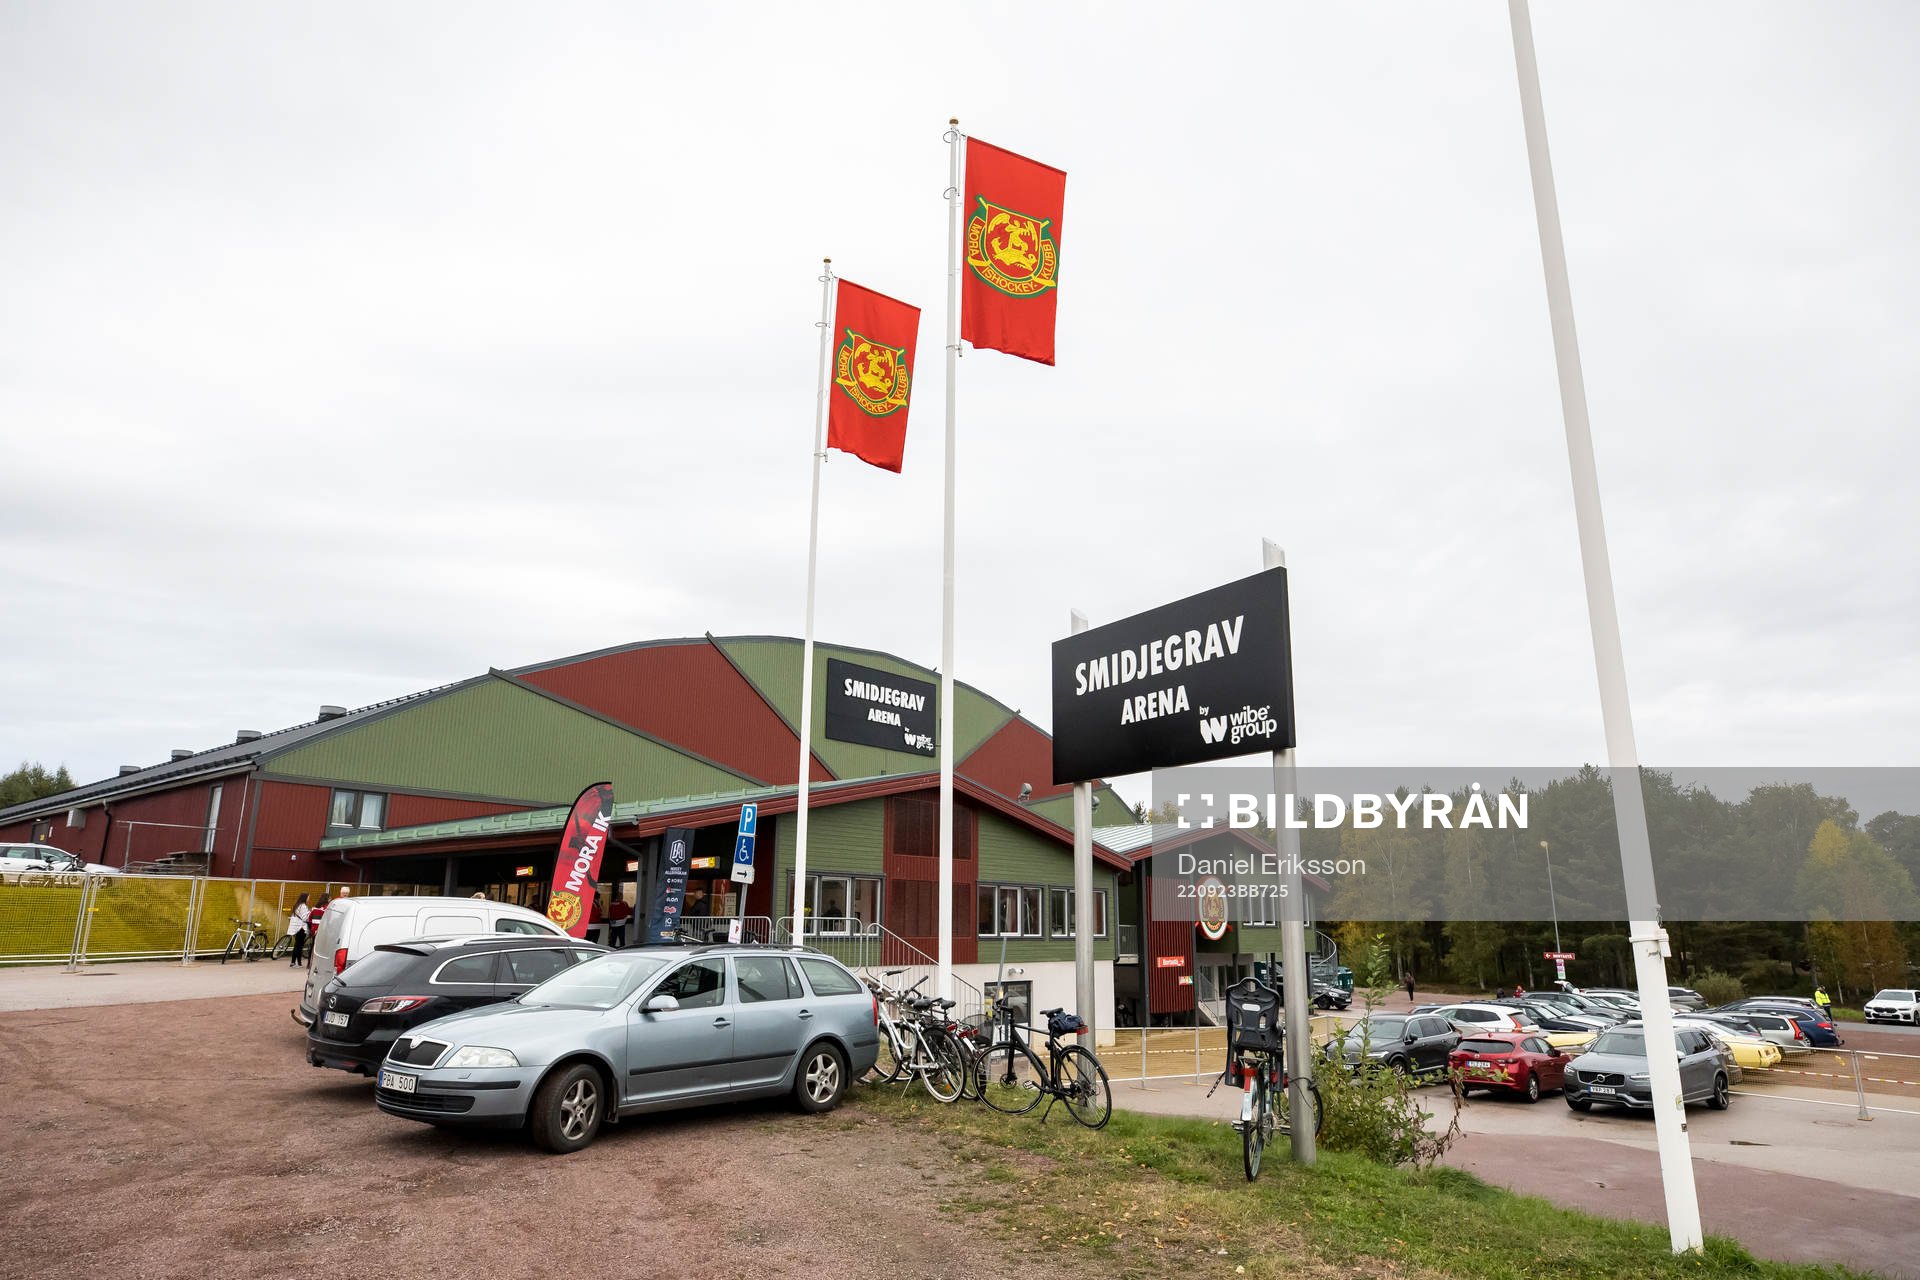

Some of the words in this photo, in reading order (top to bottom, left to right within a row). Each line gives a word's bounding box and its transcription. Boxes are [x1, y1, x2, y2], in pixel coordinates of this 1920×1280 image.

[969, 223, 982, 256] MORA
[1041, 243, 1054, 279] KLUBB
[840, 350, 850, 377] MORA
[1075, 615, 1244, 696] SMIDJEGRAV
[844, 678, 925, 711] SMIDJEGRAV
[1121, 685, 1190, 725] ARENA
[867, 708, 901, 726] ARENA
[1199, 705, 1209, 716] by
[1230, 705, 1268, 726] wibe
[1231, 719, 1277, 744] group
[744, 807, 753, 831] P
[565, 835, 603, 892] MORA
[592, 810, 611, 833] IK
[383, 1073, 395, 1089] PBA
[398, 1075, 414, 1091] 500
